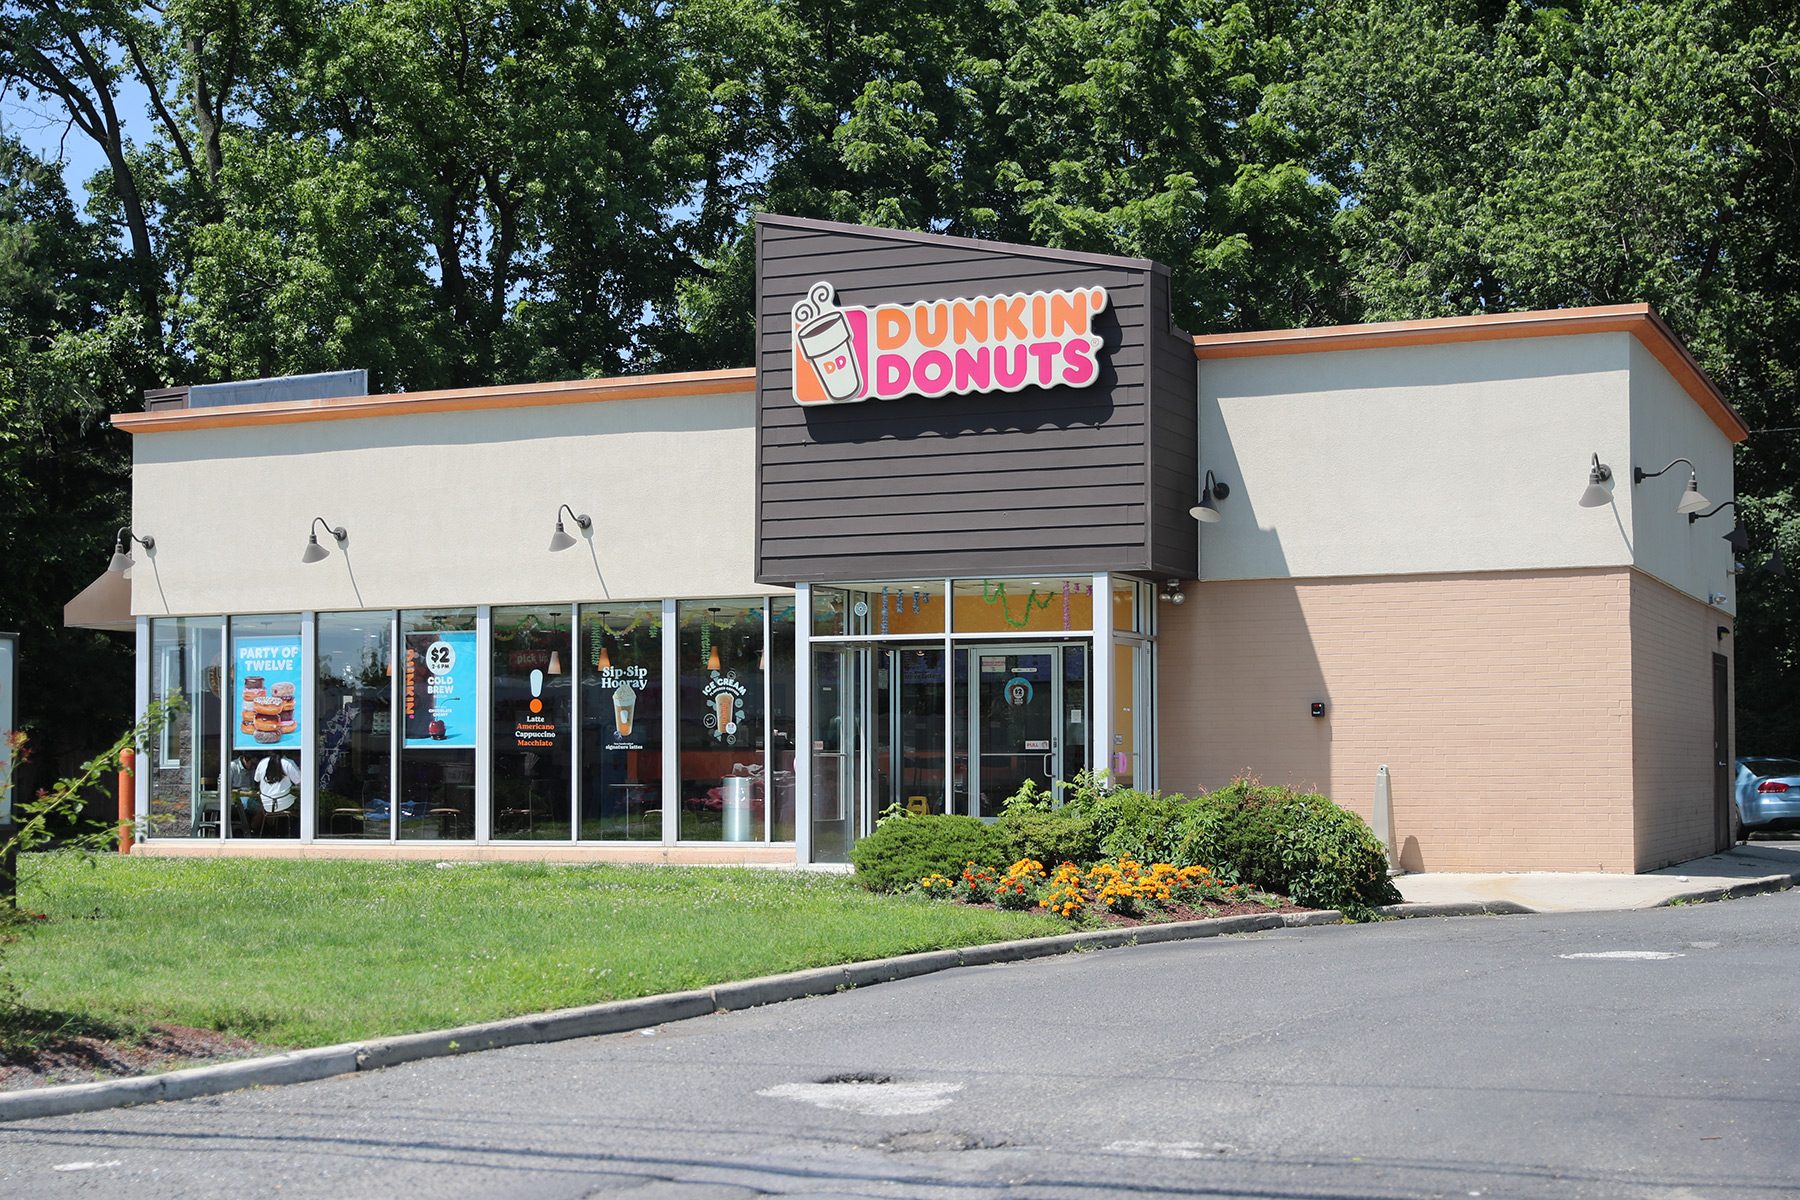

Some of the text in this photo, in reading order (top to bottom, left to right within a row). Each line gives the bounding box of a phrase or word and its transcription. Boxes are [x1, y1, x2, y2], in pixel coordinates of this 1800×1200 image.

[876, 291, 1103, 350] DUNKIN'
[823, 355, 847, 375] DD
[876, 339, 1093, 396] DONUTS
[240, 647, 298, 659] PARTY OF
[431, 647, 450, 663] $2
[245, 660, 293, 671] TWELVE
[427, 676, 453, 685] COLD
[702, 681, 716, 696] ICE
[717, 678, 747, 696] CREAM
[427, 685, 454, 694] BREW
